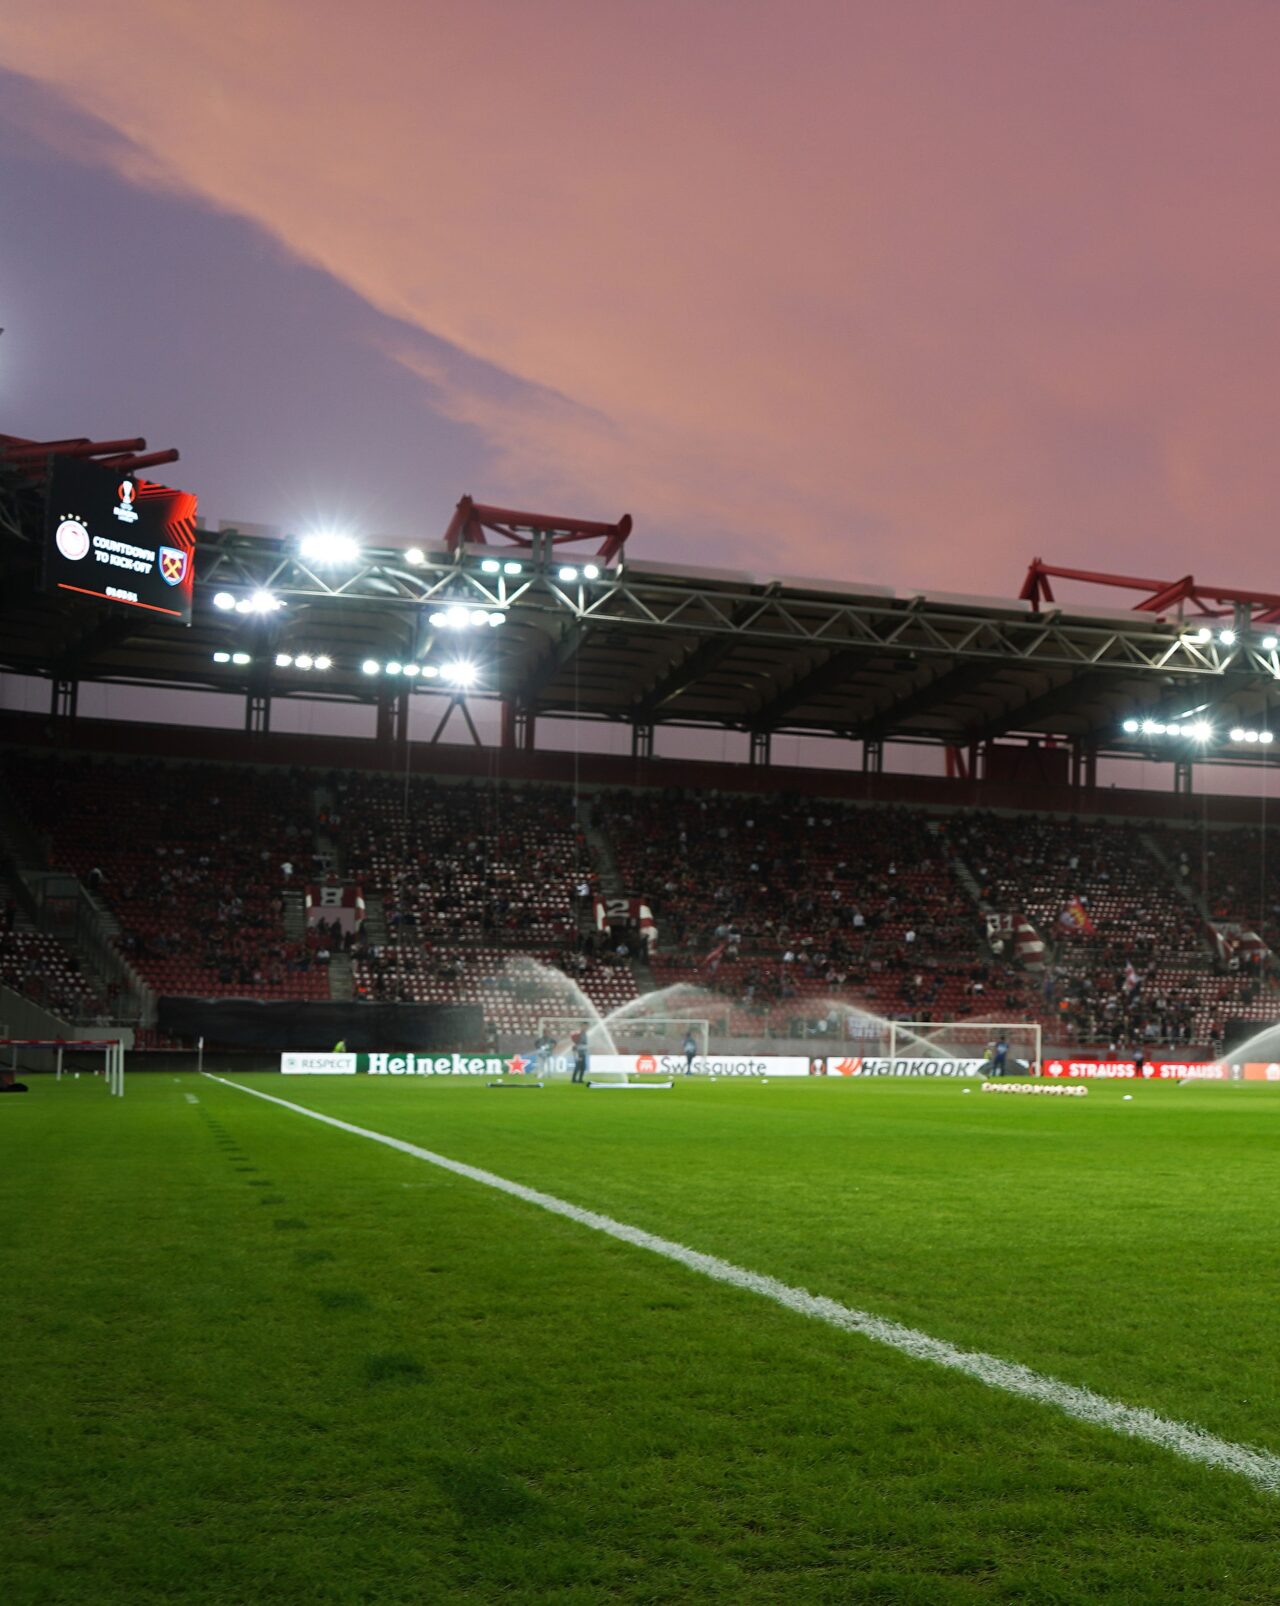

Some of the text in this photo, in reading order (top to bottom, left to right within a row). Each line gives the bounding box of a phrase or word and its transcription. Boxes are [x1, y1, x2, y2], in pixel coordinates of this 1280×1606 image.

[92, 536, 156, 562] COUNTDOWN
[94, 550, 153, 574] TO KICK-OFF
[301, 1058, 351, 1069] RESPECT
[367, 1052, 503, 1075] Heineken
[660, 1056, 767, 1076] Swssquote
[1069, 1063, 1135, 1078] STRAUSS
[1160, 1064, 1223, 1078] STRAUSS
